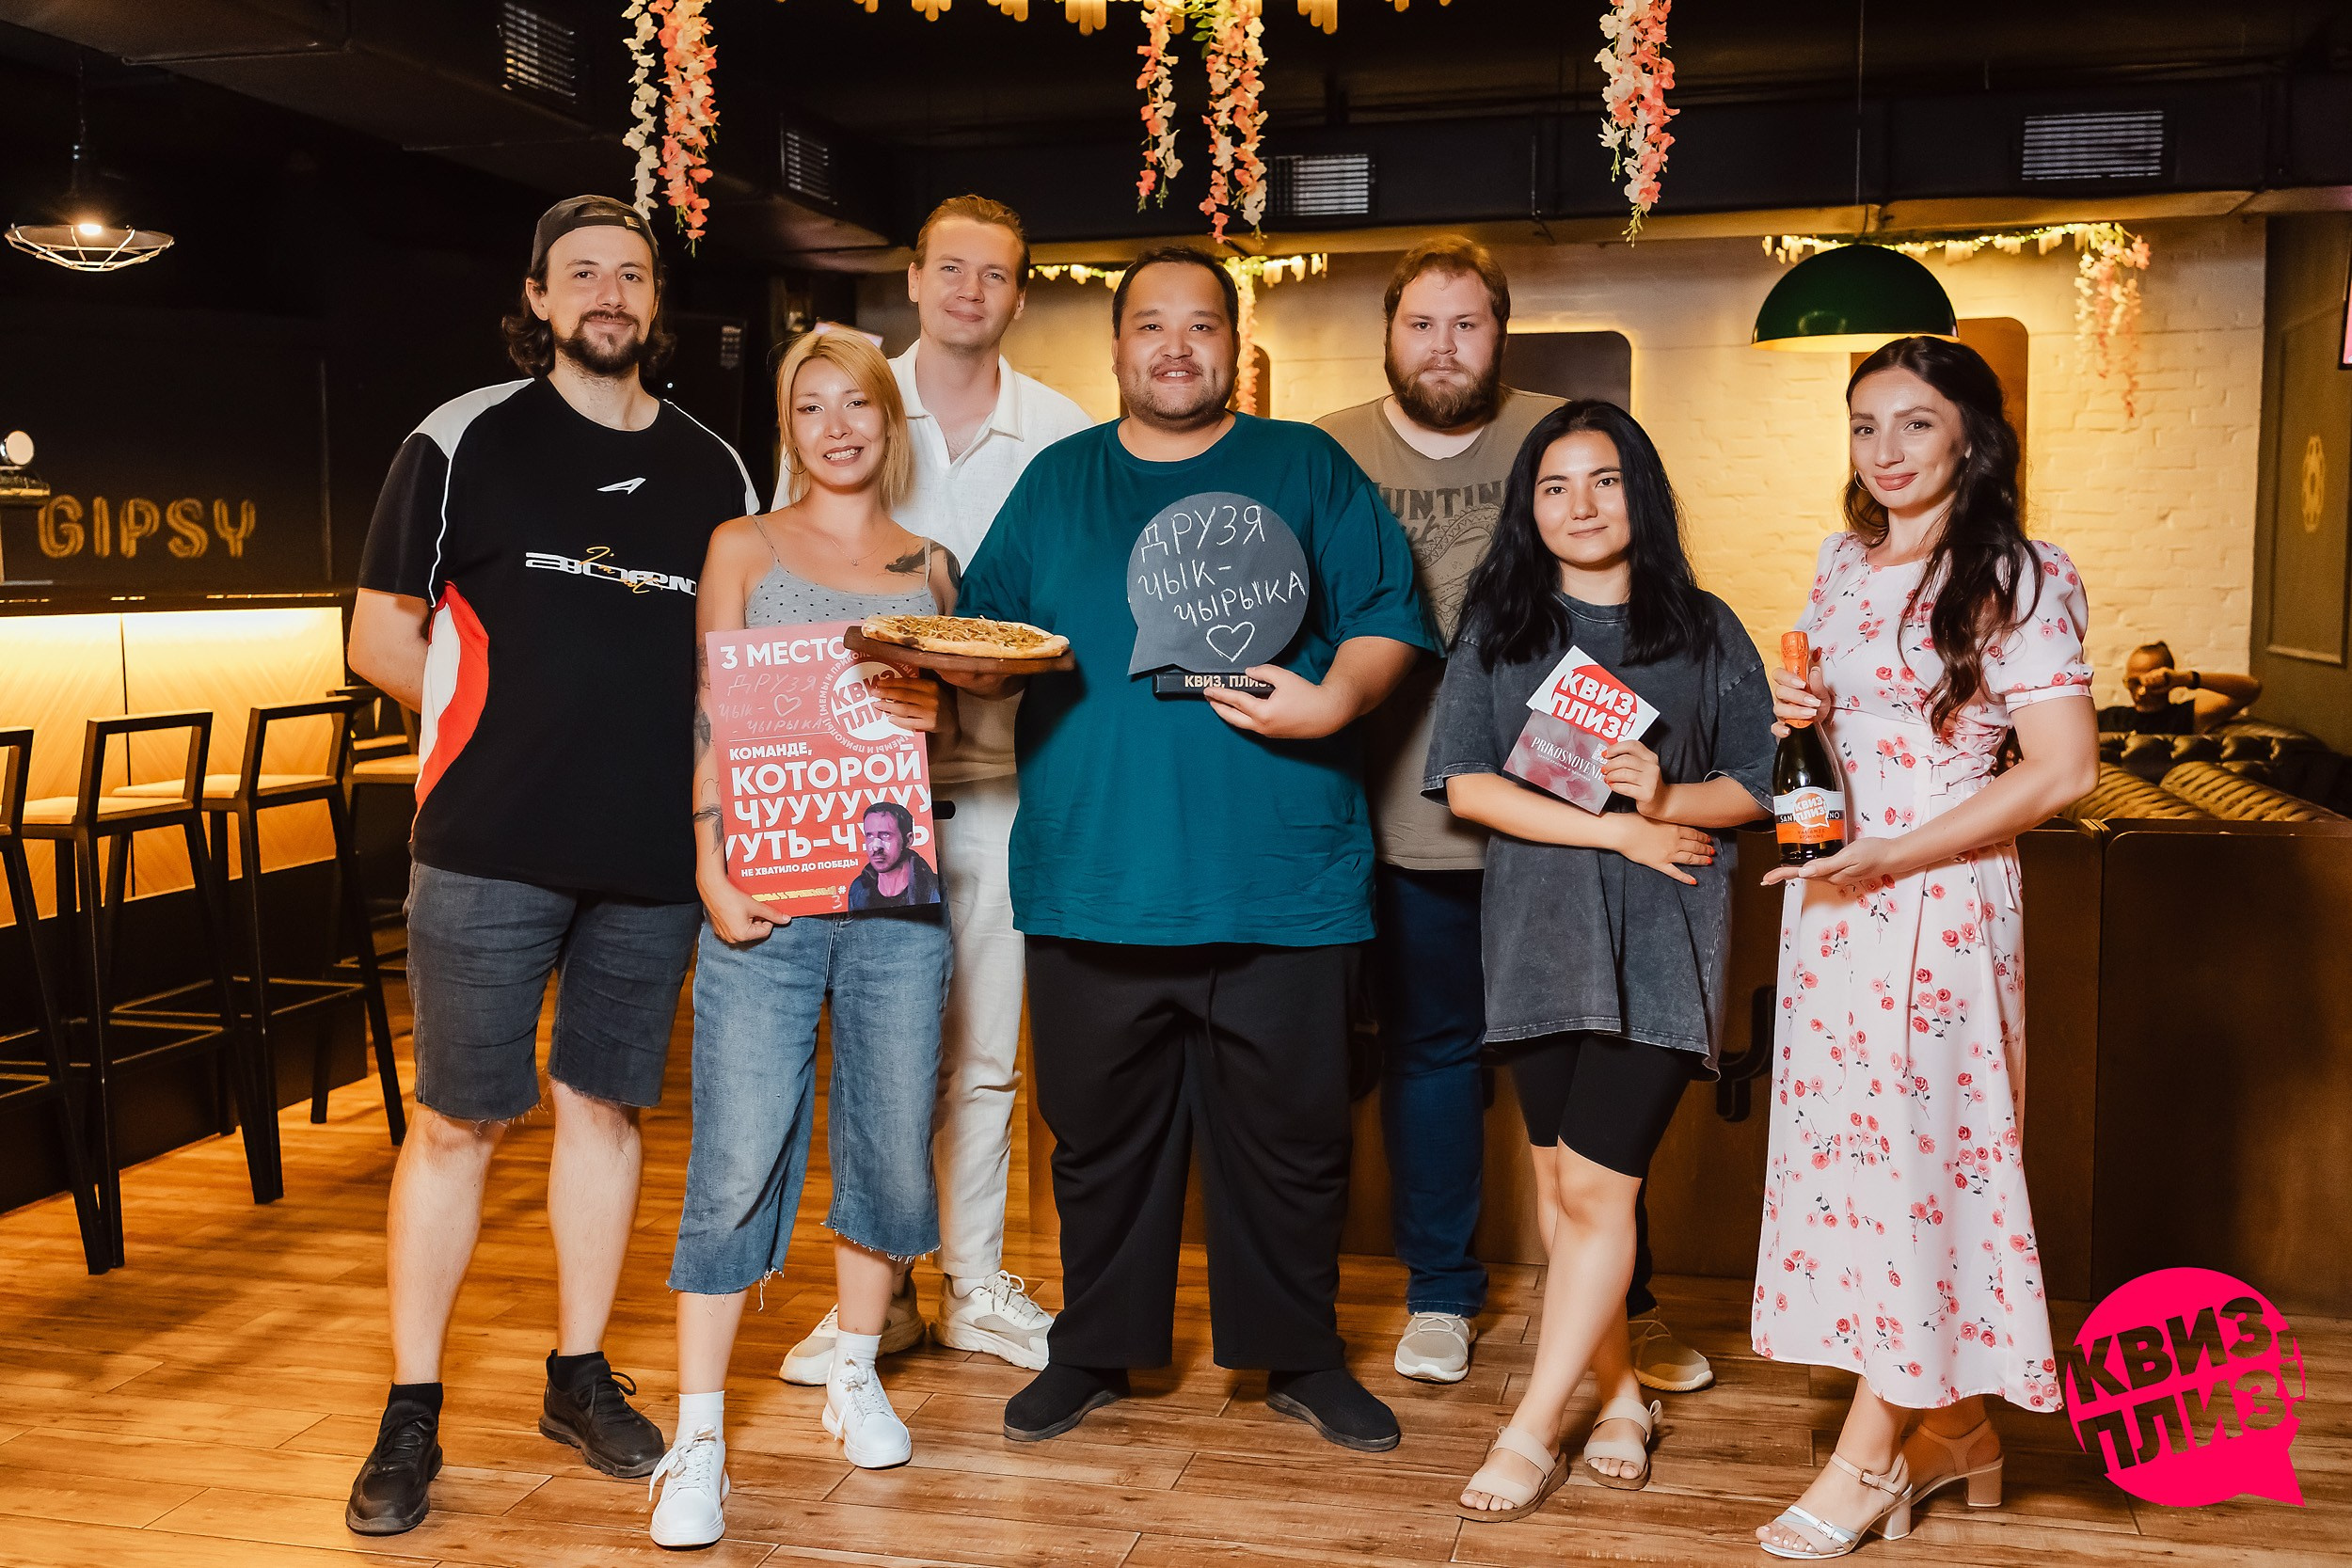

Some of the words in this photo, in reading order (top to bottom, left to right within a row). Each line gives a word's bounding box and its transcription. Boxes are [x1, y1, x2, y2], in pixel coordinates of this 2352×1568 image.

[1375, 481, 1505, 520] UNTIN
[38, 494, 256, 558] GIPSY
[1140, 504, 1266, 563] ДРУЗЯ
[1137, 559, 1232, 602] ЧЫК-
[1173, 570, 1307, 627] ЧЫРЫКА
[720, 645, 739, 670] 3
[746, 636, 851, 668] МЕСТО
[727, 673, 817, 697] ДРУЗЯ
[1185, 674, 1225, 688] КВИЗ,
[1229, 674, 1270, 688] ПЛИ
[1559, 670, 1637, 722] КВИЗ,
[1551, 691, 1633, 742] ПЛИЗ!
[728, 741, 813, 761] КОМАНДЕ,
[731, 743, 922, 797] КОТОРОЙ
[741, 868, 754, 878] НЕ
[753, 863, 800, 877] ХВАТИЛО
[801, 863, 817, 873] ДО
[818, 858, 859, 870] ПОБЕДЫ
[832, 895, 843, 910] 3
